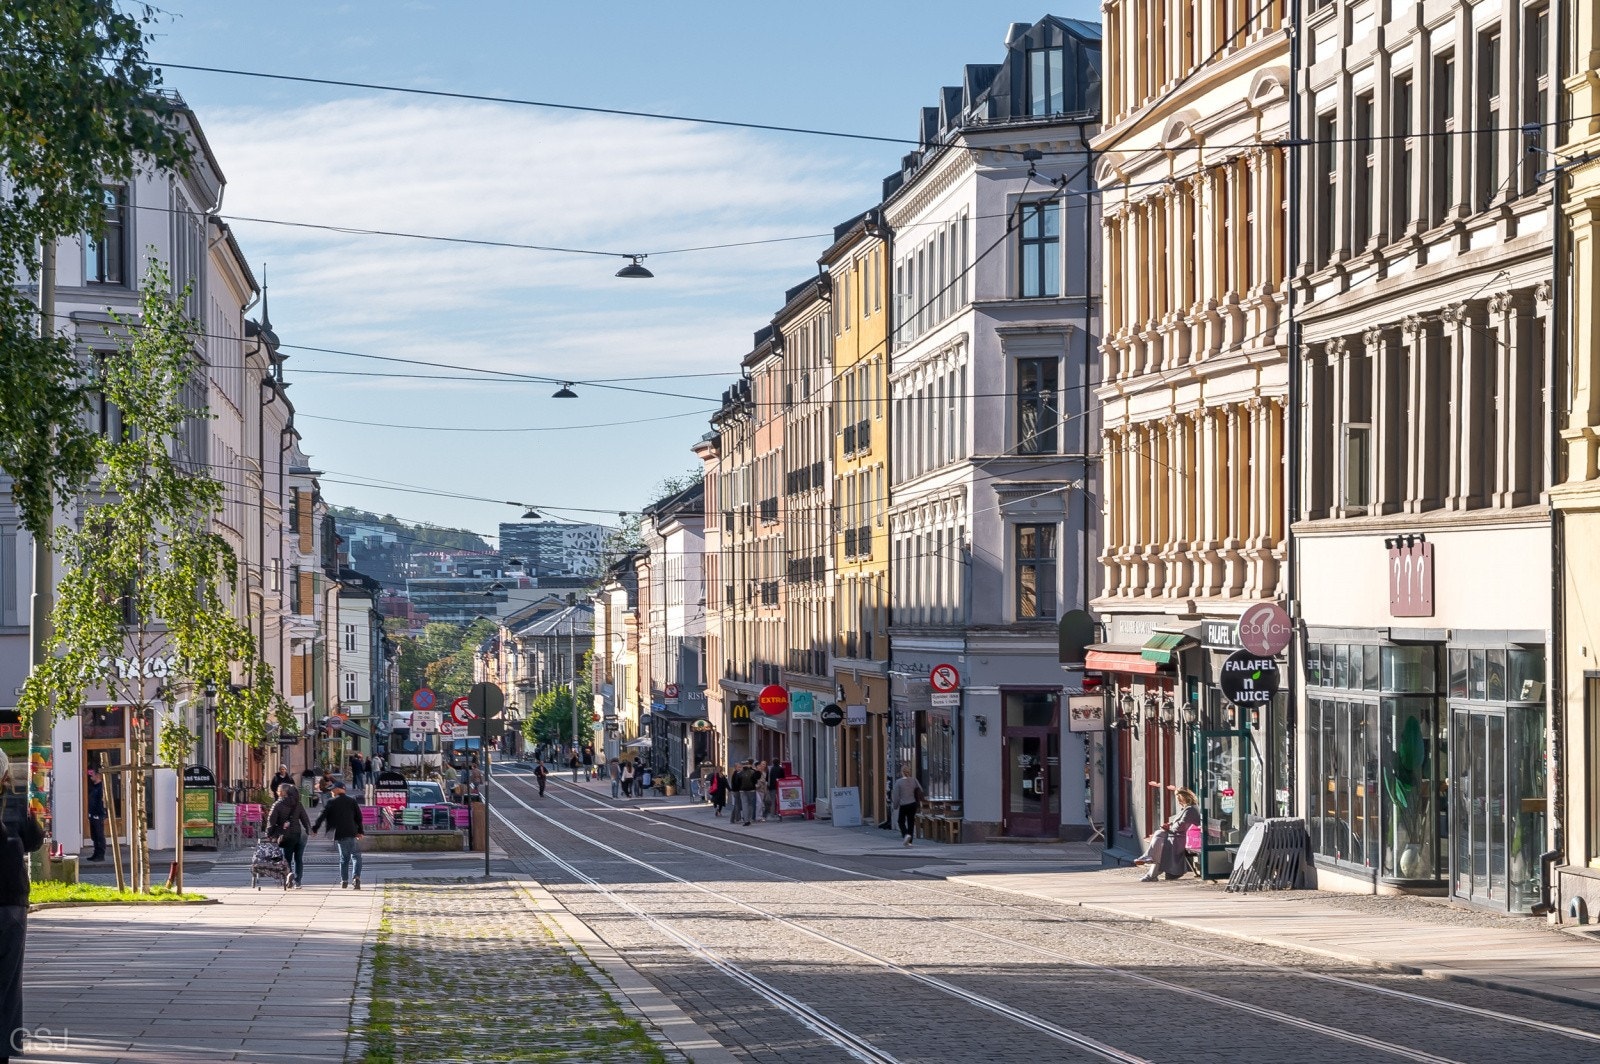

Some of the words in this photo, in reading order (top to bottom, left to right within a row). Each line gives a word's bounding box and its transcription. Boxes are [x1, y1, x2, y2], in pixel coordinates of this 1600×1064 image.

[1208, 624, 1230, 645] FALAFEL
[1225, 660, 1275, 671] FALAFEL
[1243, 678, 1254, 690] n
[1234, 691, 1269, 702] JUICE
